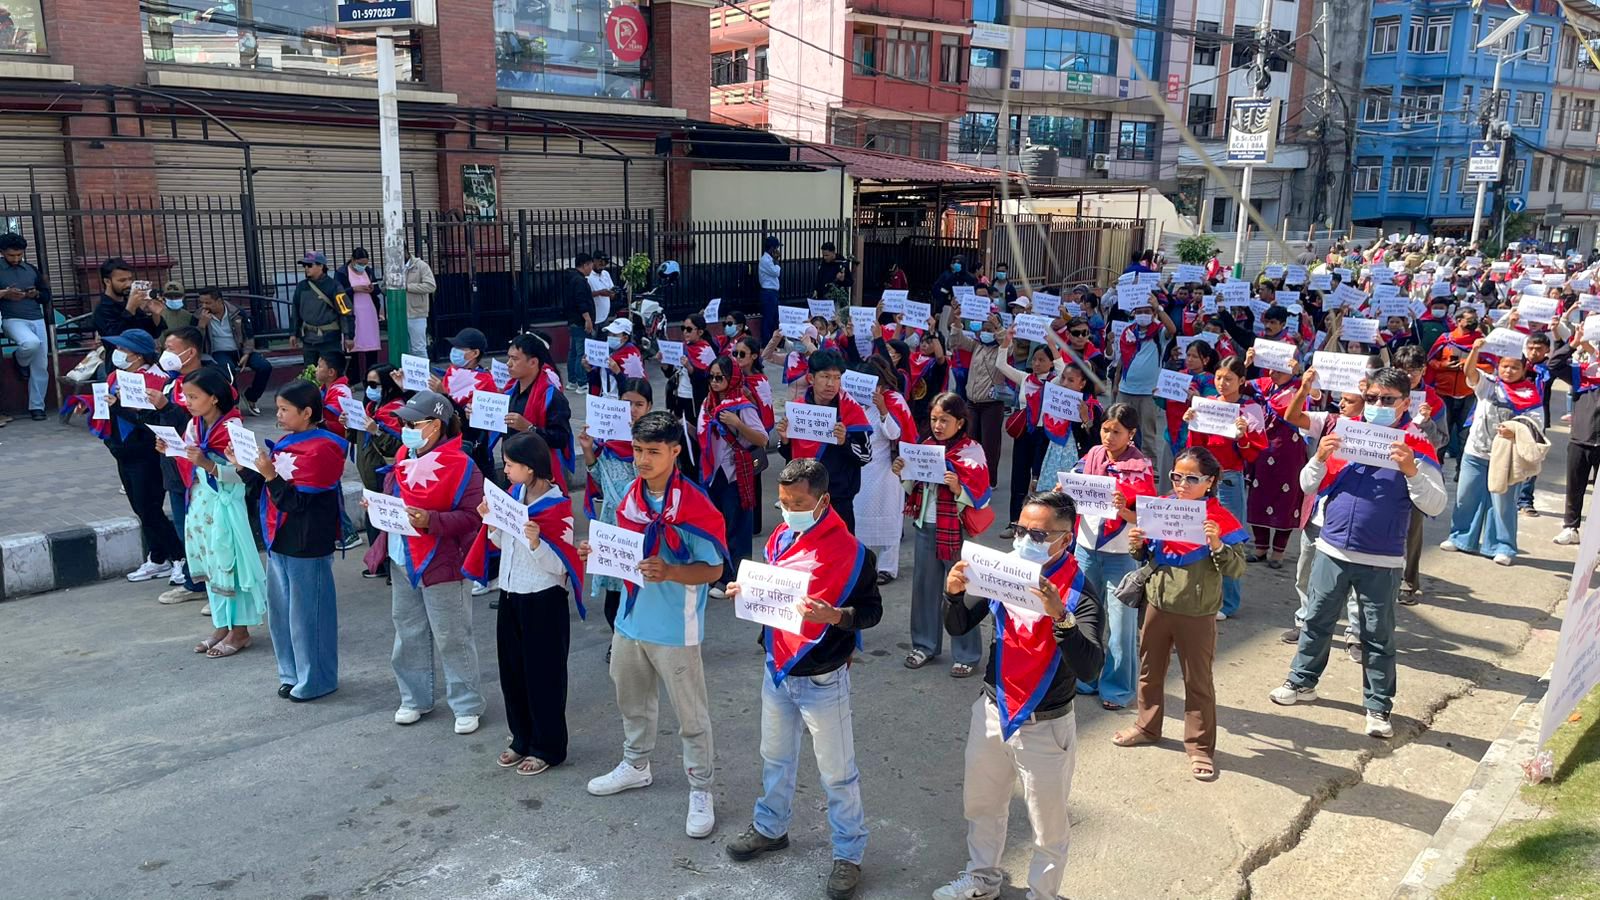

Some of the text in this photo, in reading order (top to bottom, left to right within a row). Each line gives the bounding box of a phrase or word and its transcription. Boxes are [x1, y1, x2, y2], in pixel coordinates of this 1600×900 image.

[352, 8, 396, 19] 01-5970287
[1346, 425, 1398, 440] Gen-Z united
[1085, 490, 1106, 498] पहिला
[596, 529, 638, 549] Gen-Z united
[972, 553, 1032, 581] Gen-Z united
[747, 571, 801, 589] Gen-Z united
[751, 586, 794, 603] राष्ट्र पहिला
[744, 600, 775, 615] अहंकार
